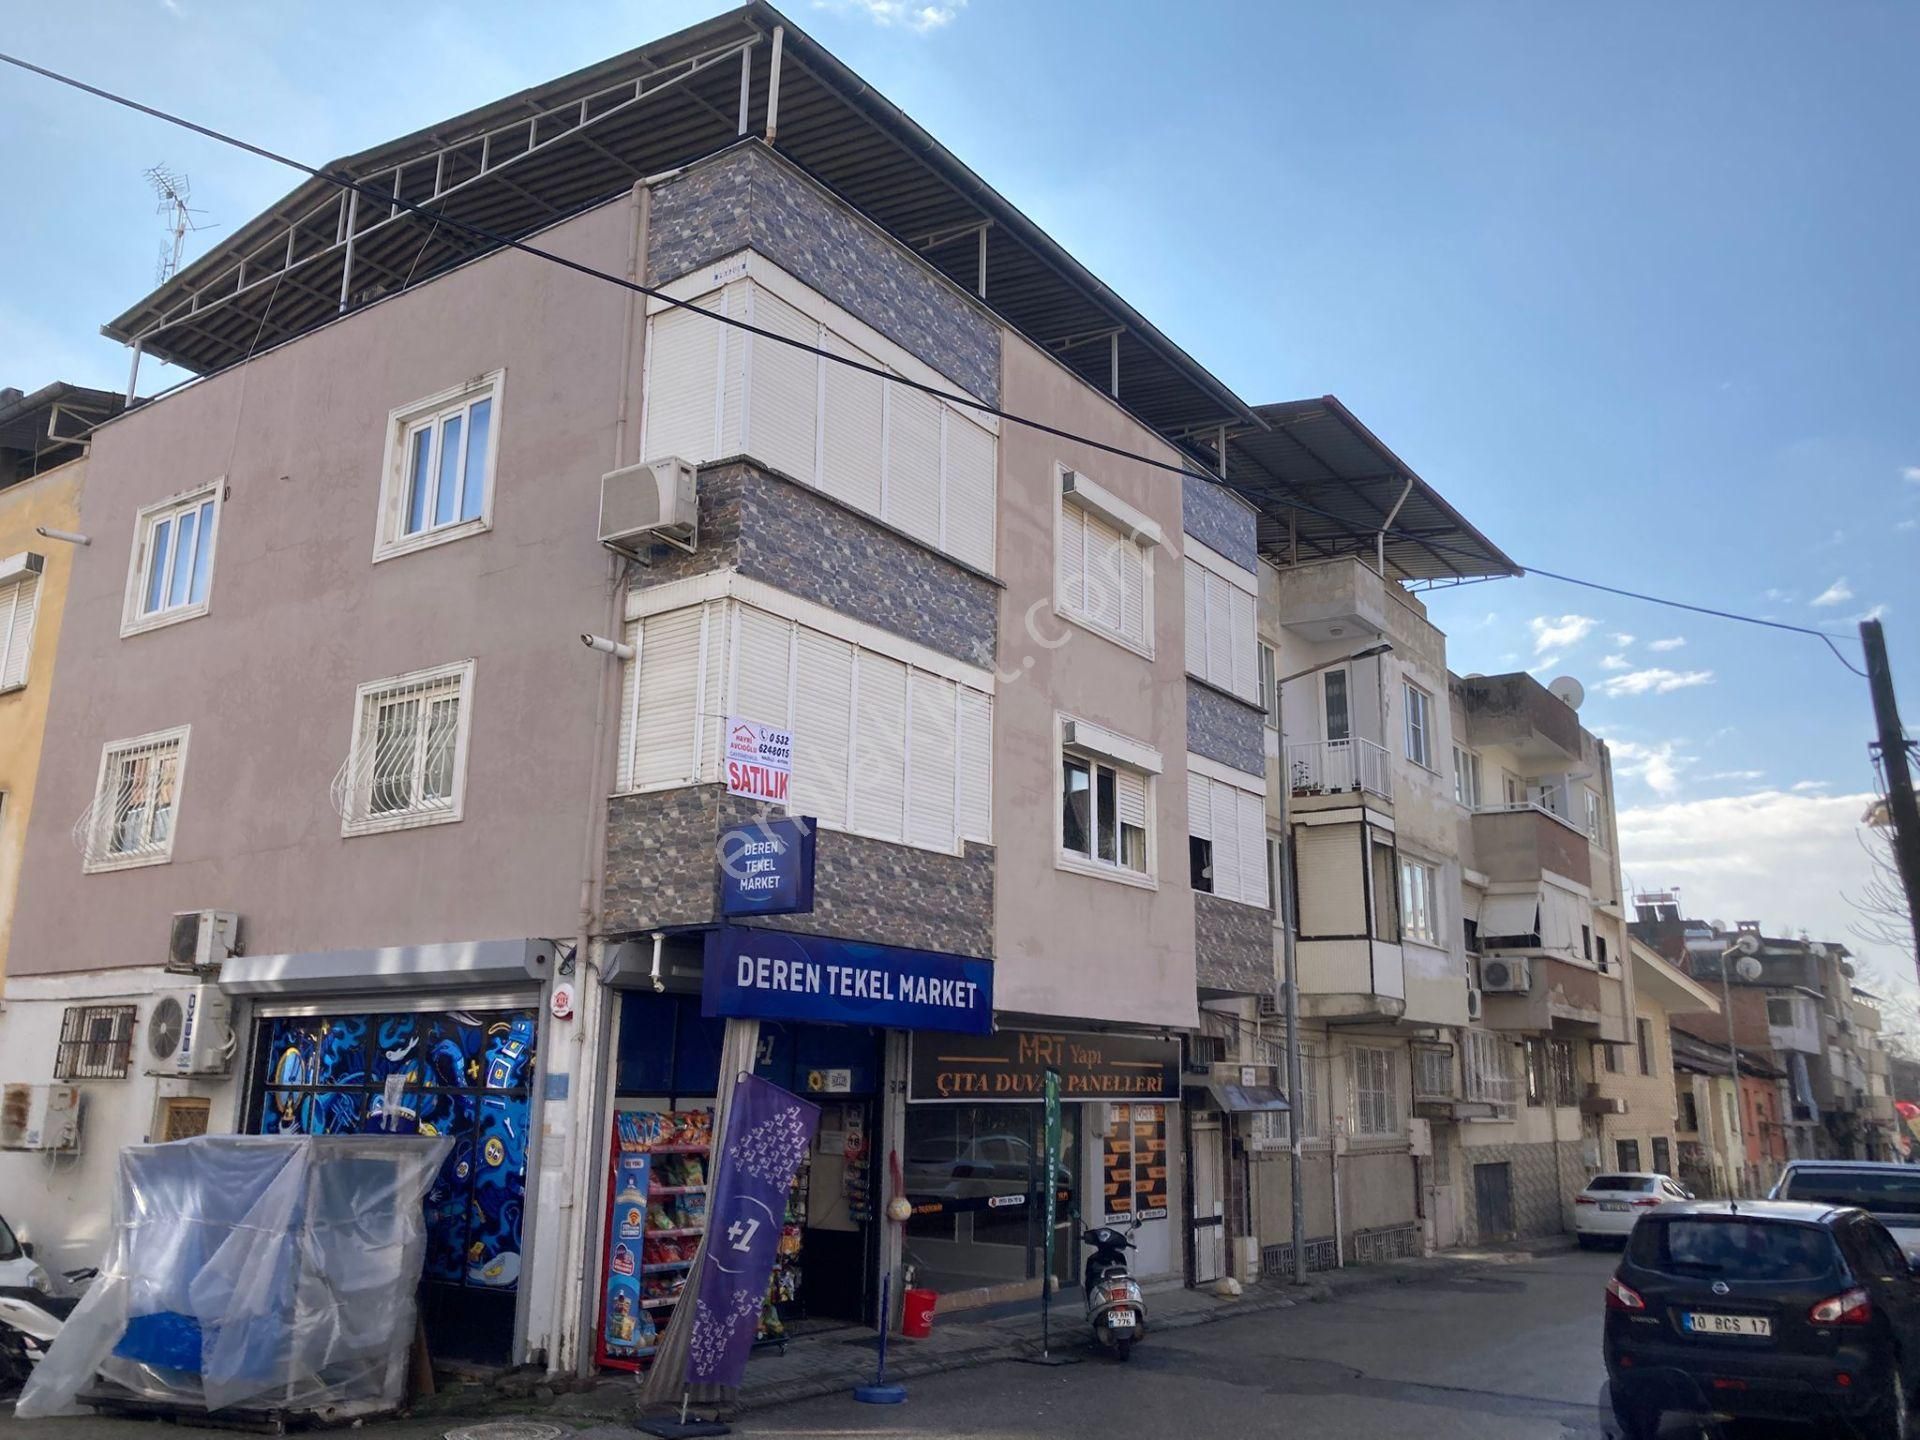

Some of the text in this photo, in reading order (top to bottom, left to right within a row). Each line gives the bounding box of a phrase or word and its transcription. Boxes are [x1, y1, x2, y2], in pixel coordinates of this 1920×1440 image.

[775, 735, 789, 745] 532
[759, 744, 790, 758] 6248015
[729, 762, 789, 799] SATILIK
[745, 841, 778, 856] DEREN
[745, 859, 776, 873] TEKEL
[740, 876, 780, 891] MARKET
[737, 955, 977, 1009] DEREN TEKEL MARKET
[1019, 1034, 1103, 1071] MRT Yapı
[937, 1073, 989, 1096] ÇITA
[1067, 1073, 1163, 1093] PANELLERİ
[727, 1218, 760, 1253] +1
[1691, 1316, 1767, 1333] 10 BCS 17
